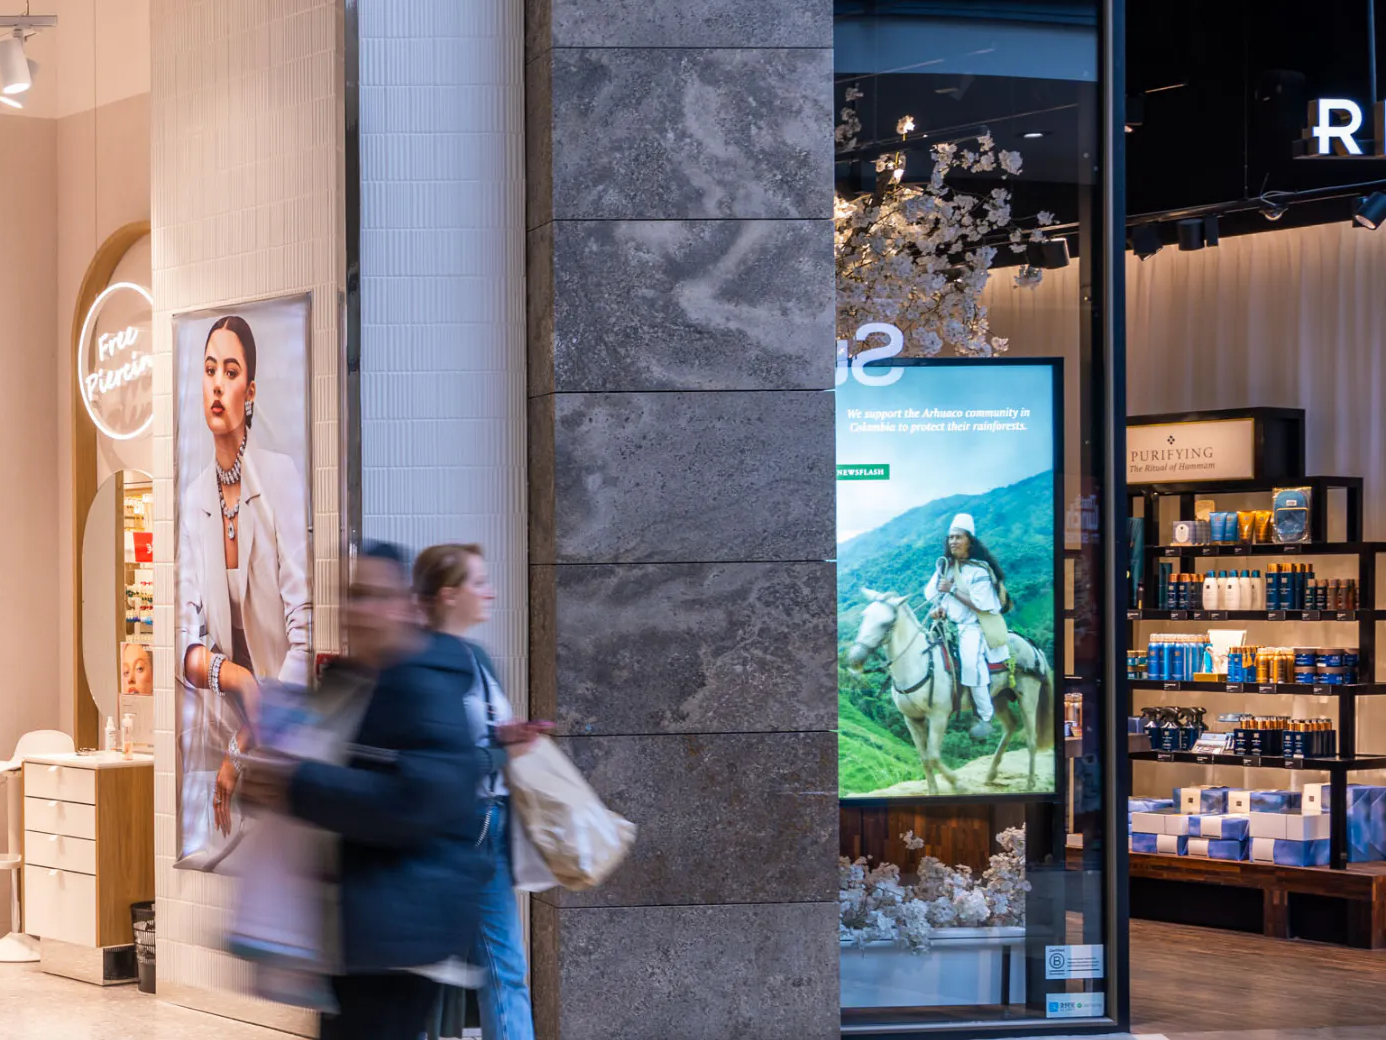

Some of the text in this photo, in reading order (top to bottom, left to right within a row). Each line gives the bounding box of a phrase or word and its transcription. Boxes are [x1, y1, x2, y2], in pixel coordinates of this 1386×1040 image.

[1312, 98, 1386, 154] R
[98, 326, 139, 362] Free
[85, 353, 154, 401] Piercin
[847, 408, 1031, 421] We support the Arhuaco community in
[850, 421, 1028, 434] Colombia to protect their rainforests.
[1131, 446, 1213, 462] PURIFYING
[837, 468, 884, 477] NEWSFLASH
[1130, 462, 1215, 473] The Ritual of Hammam
[1053, 955, 1061, 966] B
